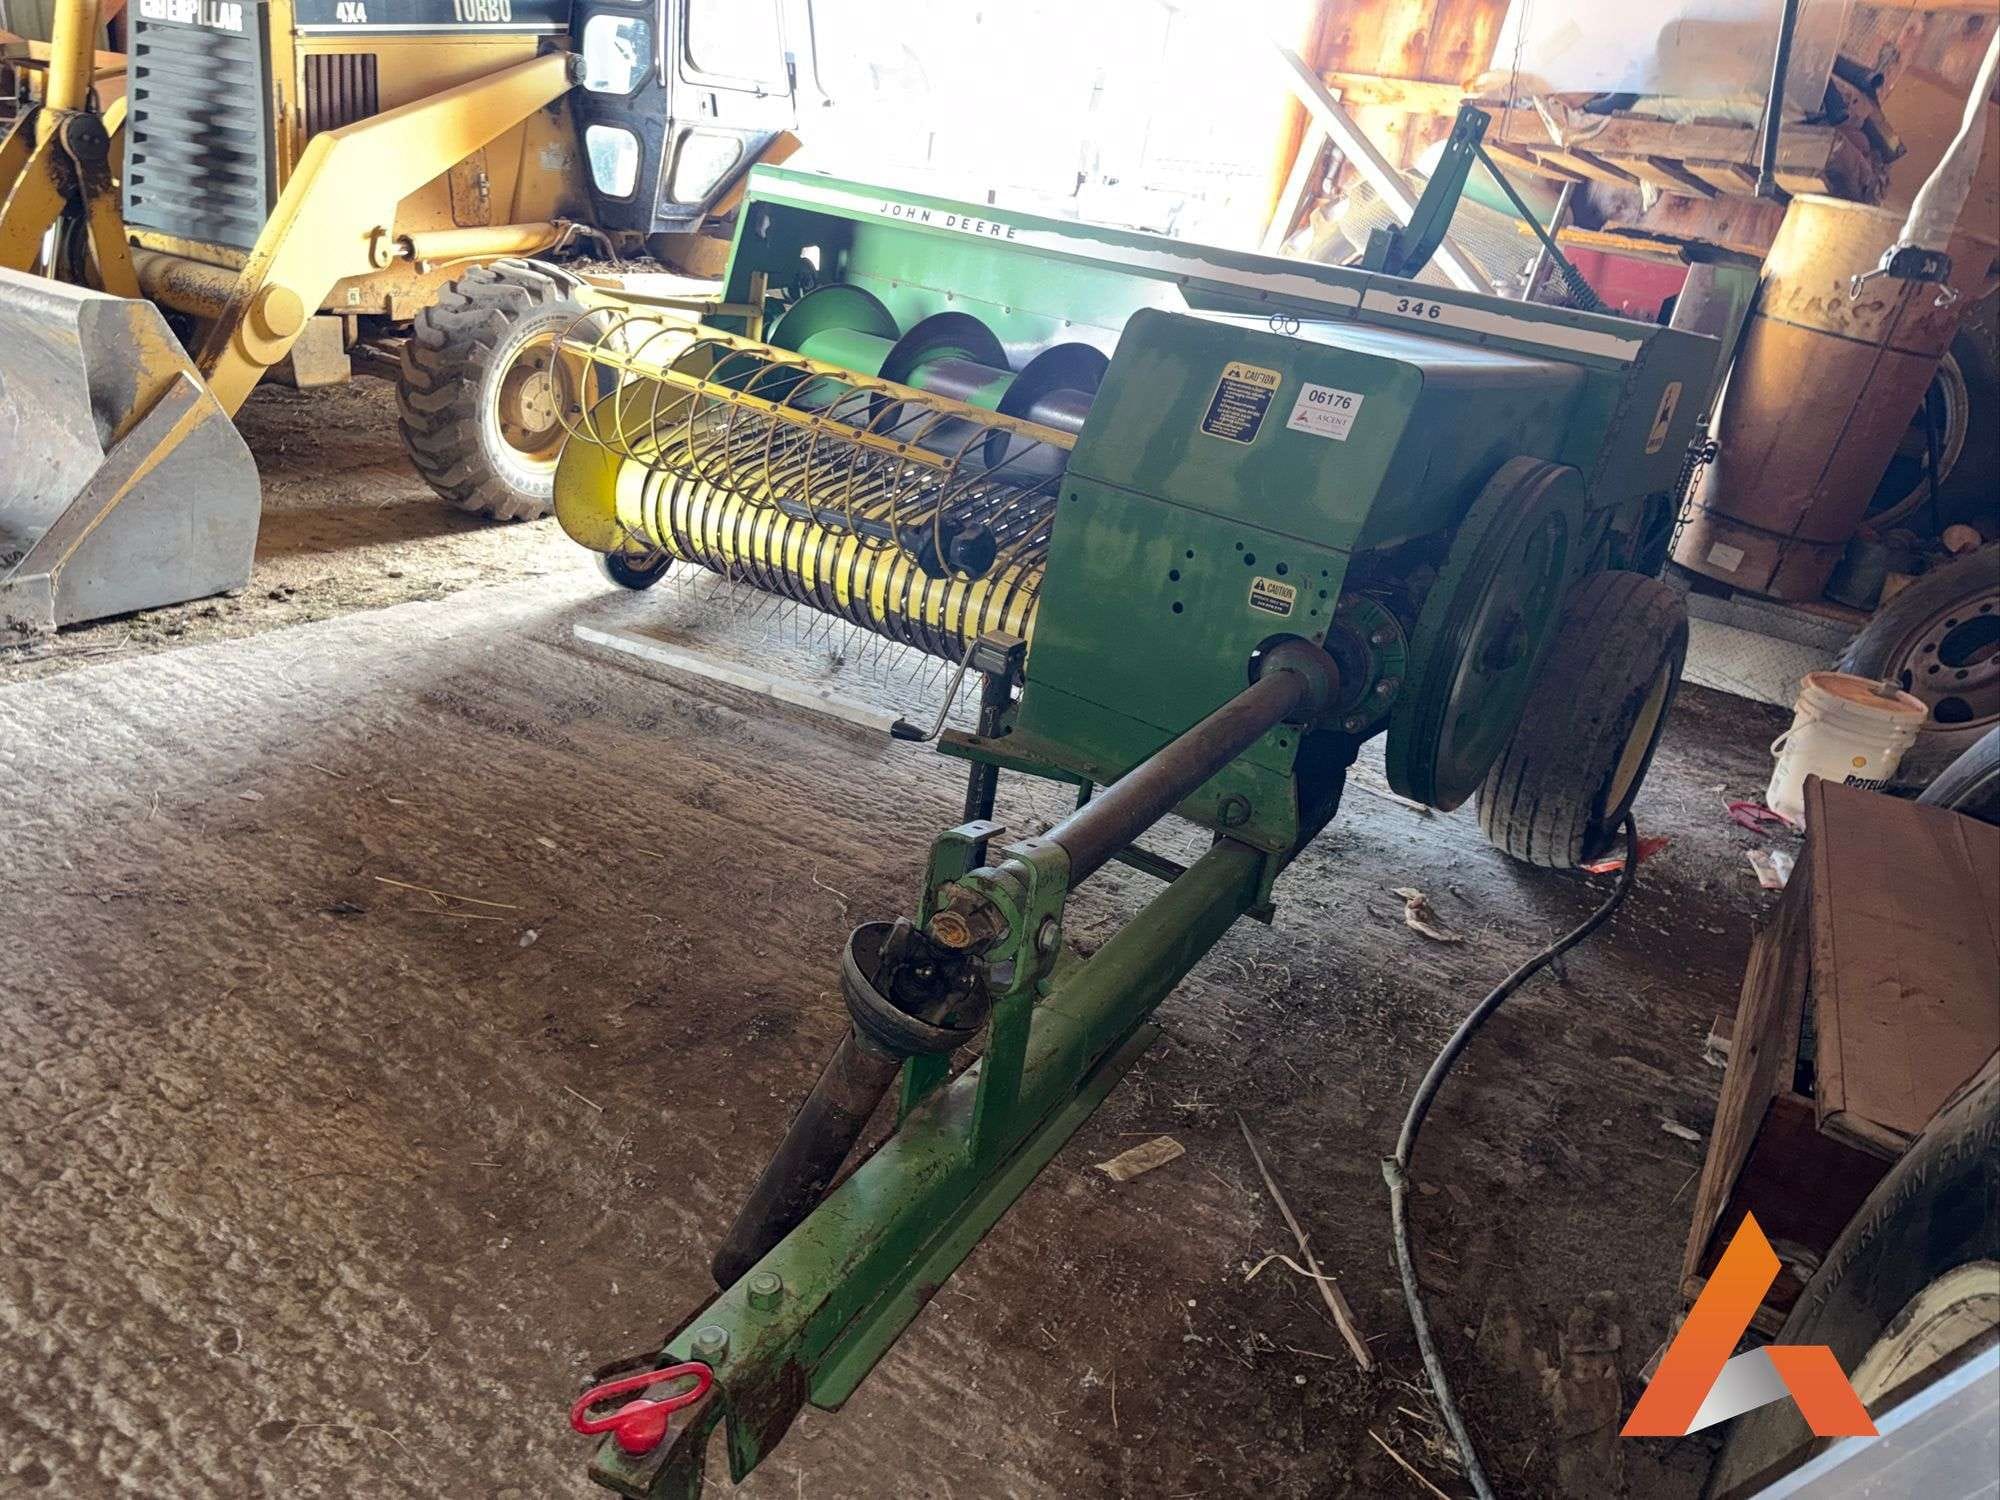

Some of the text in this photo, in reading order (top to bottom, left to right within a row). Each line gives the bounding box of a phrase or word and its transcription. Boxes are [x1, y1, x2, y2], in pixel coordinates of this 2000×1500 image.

[336, 2, 368, 23] 4X4
[453, 0, 512, 22] TURBO
[880, 203, 1016, 239] JOHN DEERE
[1397, 299, 1441, 319] 346
[1244, 369, 1277, 385] CAUTION
[1309, 389, 1352, 409] 06176
[1267, 583, 1293, 599] CAUTION
[1843, 774, 1888, 791] ROTELL
